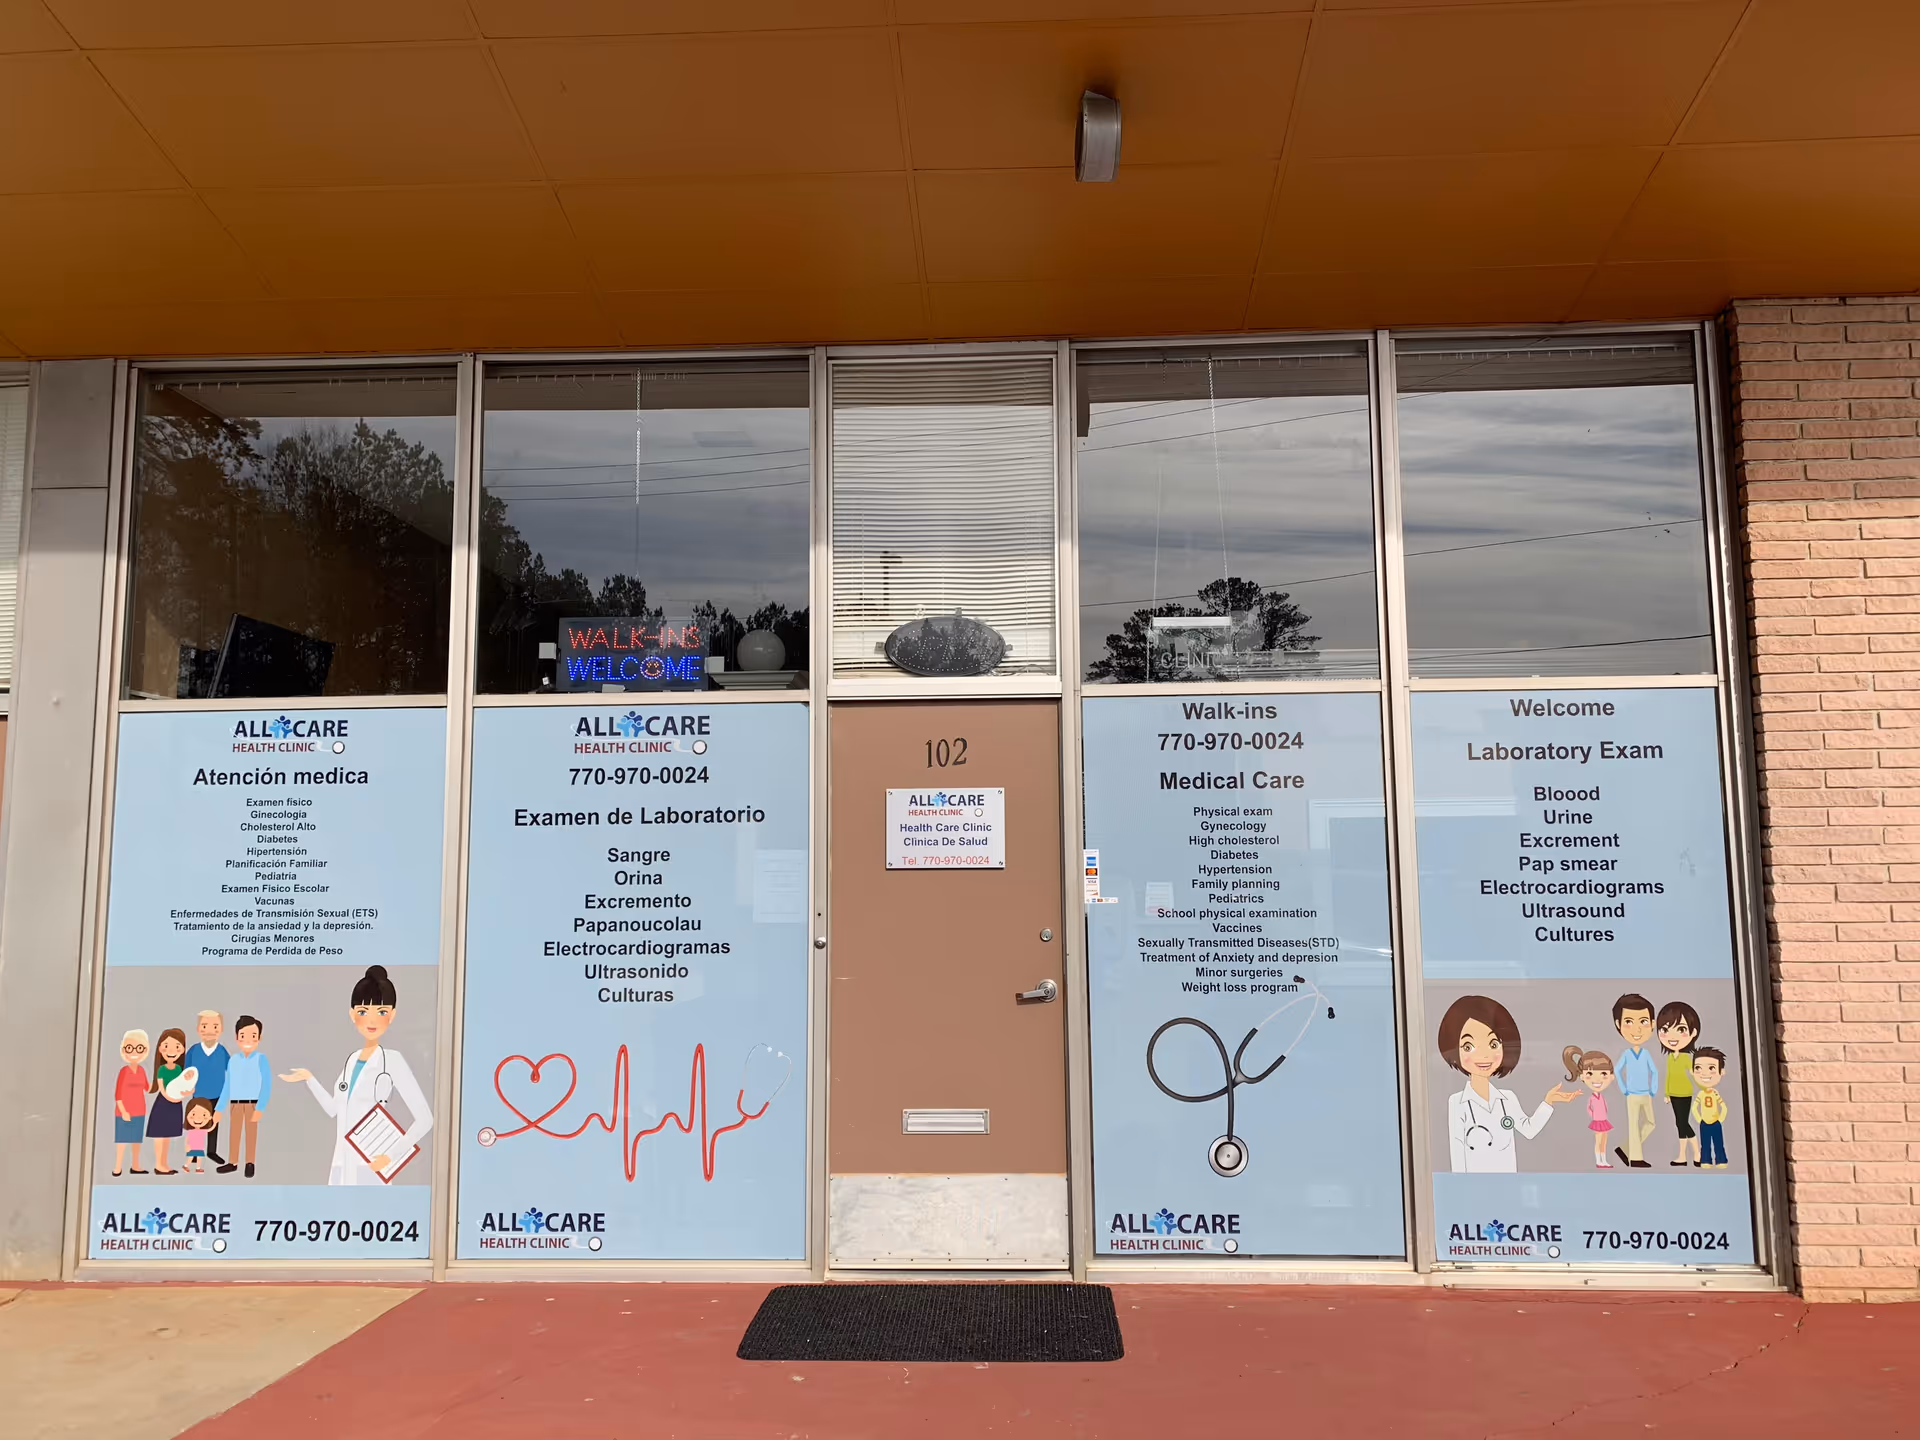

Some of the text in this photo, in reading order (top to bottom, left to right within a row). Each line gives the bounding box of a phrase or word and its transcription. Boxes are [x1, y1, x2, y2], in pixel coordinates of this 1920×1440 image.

[568, 626, 700, 649] WALK-INS
[567, 656, 700, 680] WELCOME
[1182, 702, 1277, 720] Walk-ins
[1510, 699, 1614, 716] Welcome
[233, 720, 348, 738] ALL CARE
[575, 716, 710, 736] ALL CARE
[233, 742, 315, 752] HEALTH CLINIC
[1158, 732, 1303, 750] 770-970-0024
[575, 742, 671, 754] HEALTH CLINIC
[925, 738, 968, 768] 102
[1468, 741, 1663, 764] Laboratory Exam
[193, 767, 368, 785] Atención medica
[570, 766, 709, 785] 770-970-0024
[1160, 771, 1304, 789] Medical Care
[1534, 786, 1599, 801] Bloood
[247, 798, 283, 806] Examen
[909, 795, 984, 806] ALL CARE
[515, 806, 765, 826] Examen de Laboratorio
[1194, 807, 1239, 818] Physical
[1544, 810, 1592, 824] Urine
[241, 823, 294, 831] Cholesterol
[900, 823, 991, 832] Health Care Clinic
[1201, 821, 1266, 833] Gynecology
[257, 835, 298, 843] Diabetes
[942, 837, 955, 845] De
[959, 837, 987, 845] Salud
[1190, 836, 1279, 847] High cholesterol
[1520, 833, 1620, 847] Excrement
[247, 847, 307, 857] Hipertensión
[608, 848, 670, 865] Sangre
[1211, 850, 1258, 859] Diabetes
[226, 859, 286, 868] Planificación
[923, 856, 989, 865] 770-970-0024
[1519, 857, 1617, 875] Pap smear
[1199, 865, 1272, 876] Hypertension
[615, 871, 662, 885] Orina
[294, 884, 329, 892] Escolar
[1192, 879, 1279, 891] Family planning
[1481, 880, 1664, 898] Electrocardiograms
[255, 897, 294, 905] Vacunas
[585, 894, 691, 909] Excremento
[1209, 894, 1264, 903] Pediatrics
[171, 910, 238, 918] Enfermedades
[256, 909, 314, 917] Transmisión
[317, 909, 349, 917] Sexual
[352, 909, 378, 919] (ETS)
[1158, 908, 1316, 920] School physical examination
[1523, 903, 1624, 918] Ultrasound
[174, 922, 230, 930] Tratamiento
[233, 922, 244, 930] de
[247, 922, 255, 930] la
[258, 922, 301, 930] ansiedad
[304, 923, 310, 932] y
[323, 921, 373, 931] depresión.
[574, 916, 701, 936] Papanoucolau
[1213, 923, 1262, 932] Vaccines
[274, 934, 314, 942] Menores
[1536, 927, 1614, 941] Cultures
[544, 940, 730, 958] Electrocardiogramas
[1138, 938, 1339, 949] Sexually Transmitted Diseases(STD)
[202, 947, 248, 957] Programa
[251, 947, 262, 955] de
[266, 947, 301, 955] Perdida
[305, 947, 316, 955] de
[1140, 952, 1338, 964] Treatment of Anxiety and depresion
[585, 963, 688, 979] Ultrasonido
[1196, 968, 1283, 979] Minor surgeries
[1182, 982, 1297, 994] Weight loss program
[598, 988, 673, 1002] Culturas
[1705, 1097, 1713, 1108] 8
[102, 1213, 230, 1233] ALL CARE
[482, 1213, 605, 1233] ALL CARE
[1110, 1214, 1240, 1234] ALL CARE
[255, 1220, 419, 1241] 770-970-0024
[1450, 1224, 1562, 1242] ALL CARE
[101, 1239, 193, 1250] HEALTH CLINIC
[480, 1238, 569, 1250] HEALTH CLINIC
[1111, 1240, 1203, 1250] HEALTH CLINIC
[1583, 1231, 1729, 1250] 770-970-0024
[1449, 1246, 1530, 1255] HEALTH CLINIC
